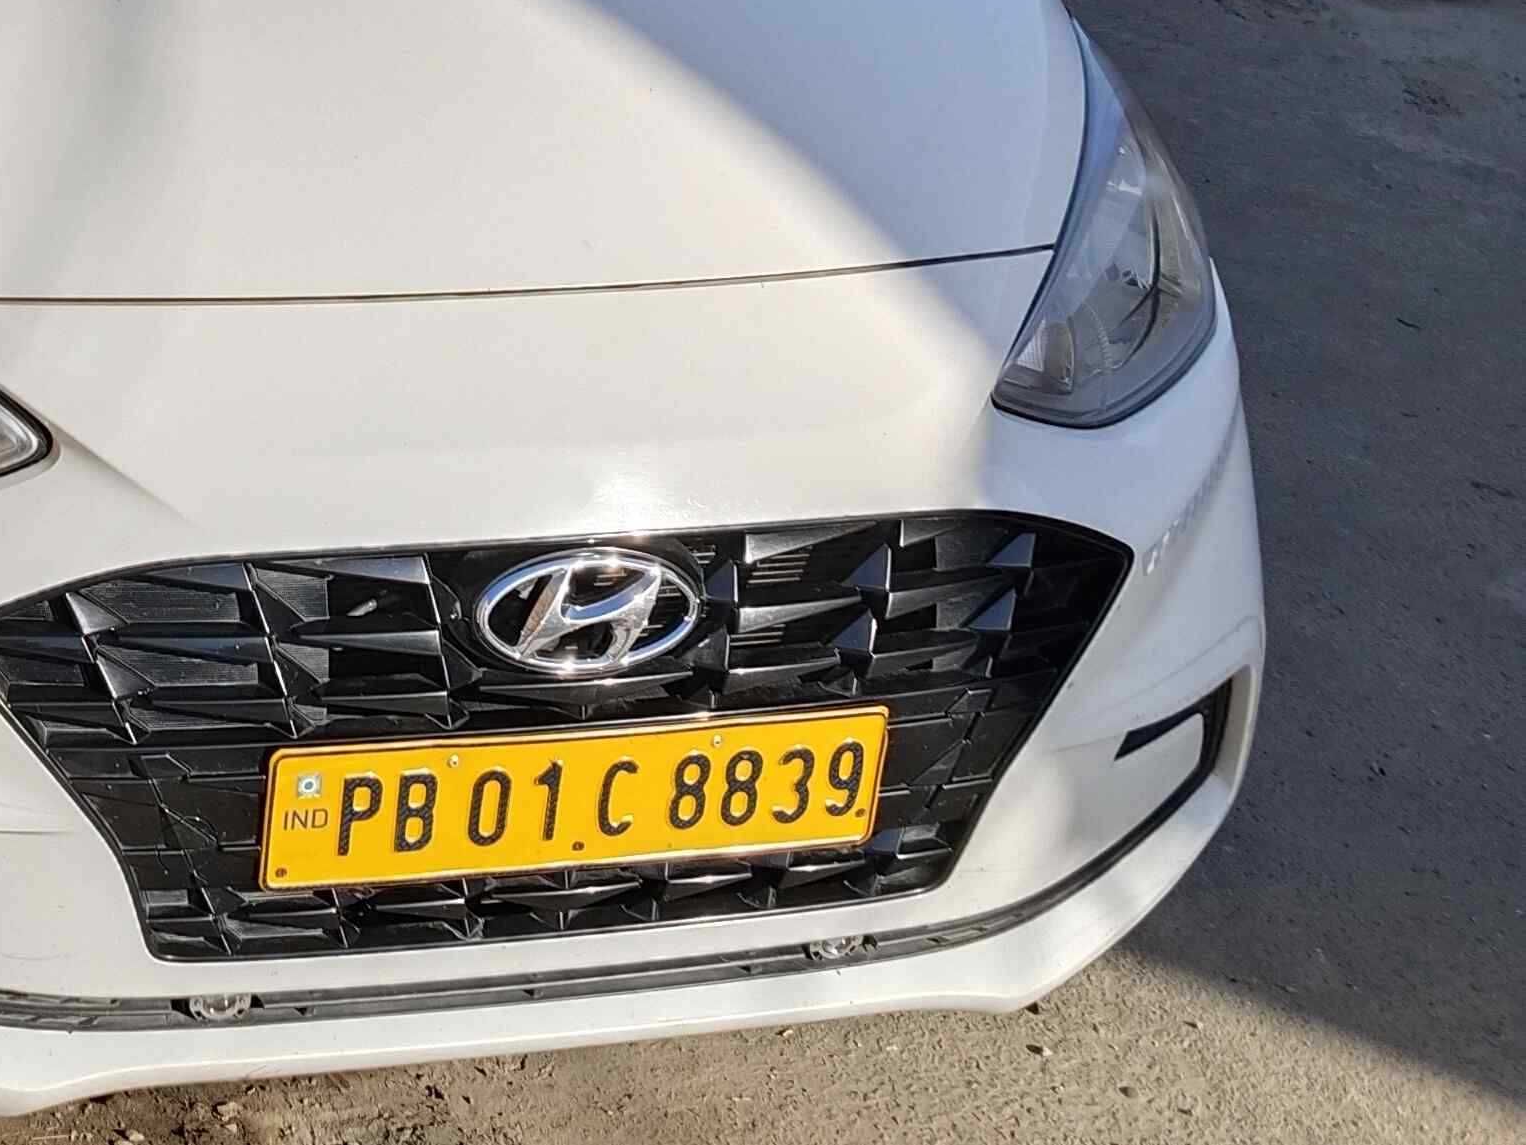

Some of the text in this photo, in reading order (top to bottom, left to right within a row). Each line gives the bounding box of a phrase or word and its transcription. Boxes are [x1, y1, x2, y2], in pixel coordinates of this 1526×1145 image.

[282, 808, 329, 832] IND
[337, 741, 866, 856] PB 01 C 8839
